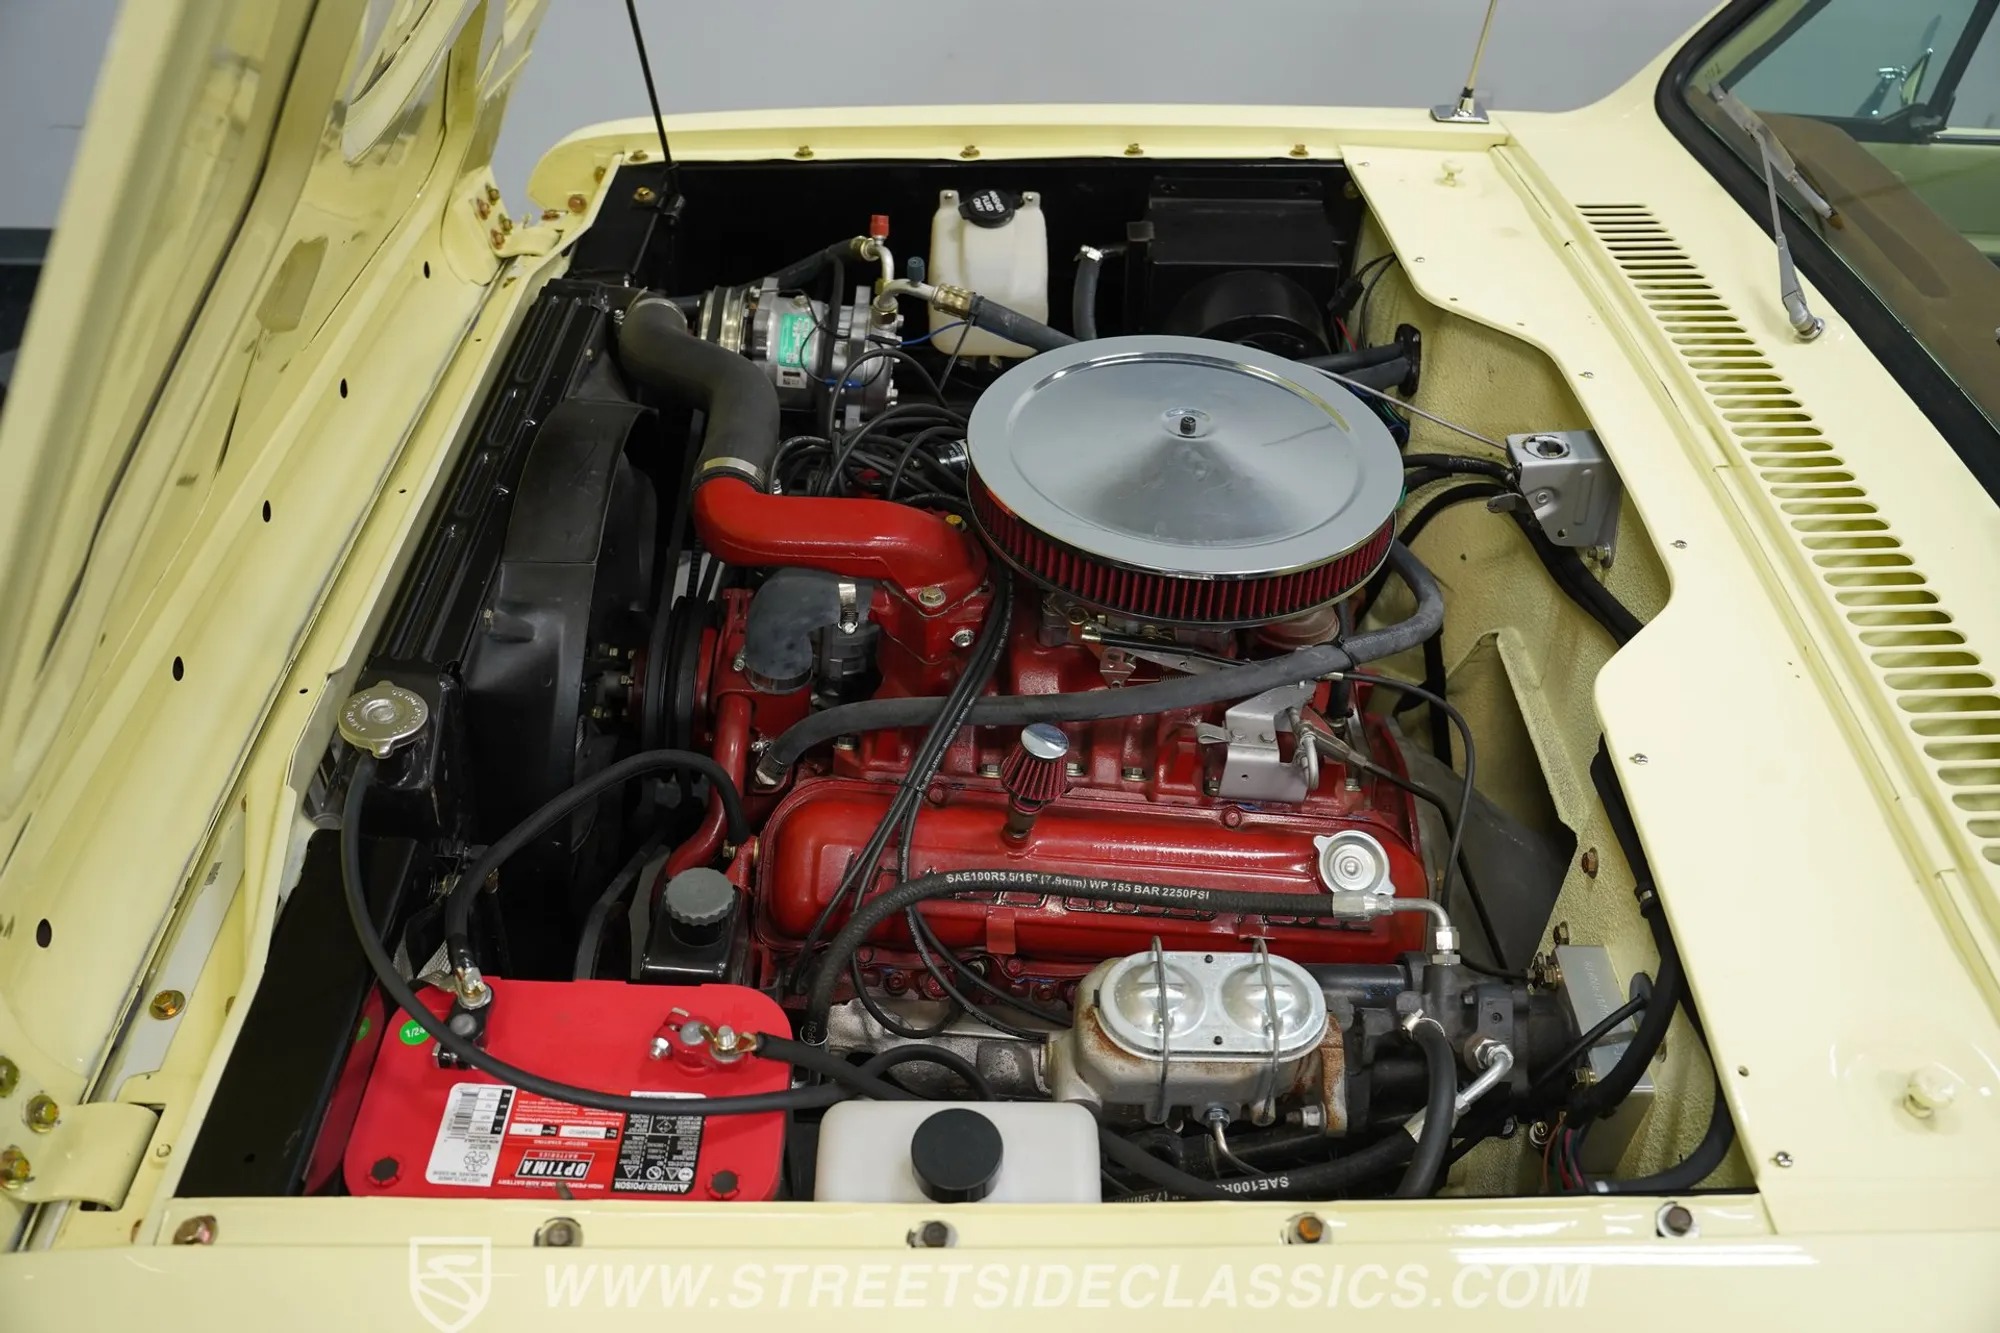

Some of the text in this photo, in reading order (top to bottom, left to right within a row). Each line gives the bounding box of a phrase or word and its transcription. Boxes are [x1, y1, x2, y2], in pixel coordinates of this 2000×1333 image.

[972, 197, 985, 211] ONLY
[980, 195, 995, 211] FLUID
[946, 871, 1006, 883] SAE100R5
[1007, 872, 1038, 883] 5/16"
[1090, 879, 1109, 890] WP
[1112, 881, 1132, 893] 155
[1134, 884, 1160, 896] BAR
[1162, 887, 1210, 900] 2250PSI
[521, 1160, 587, 1177] OPTIMA
[614, 1181, 678, 1191] DANGER/POISON
